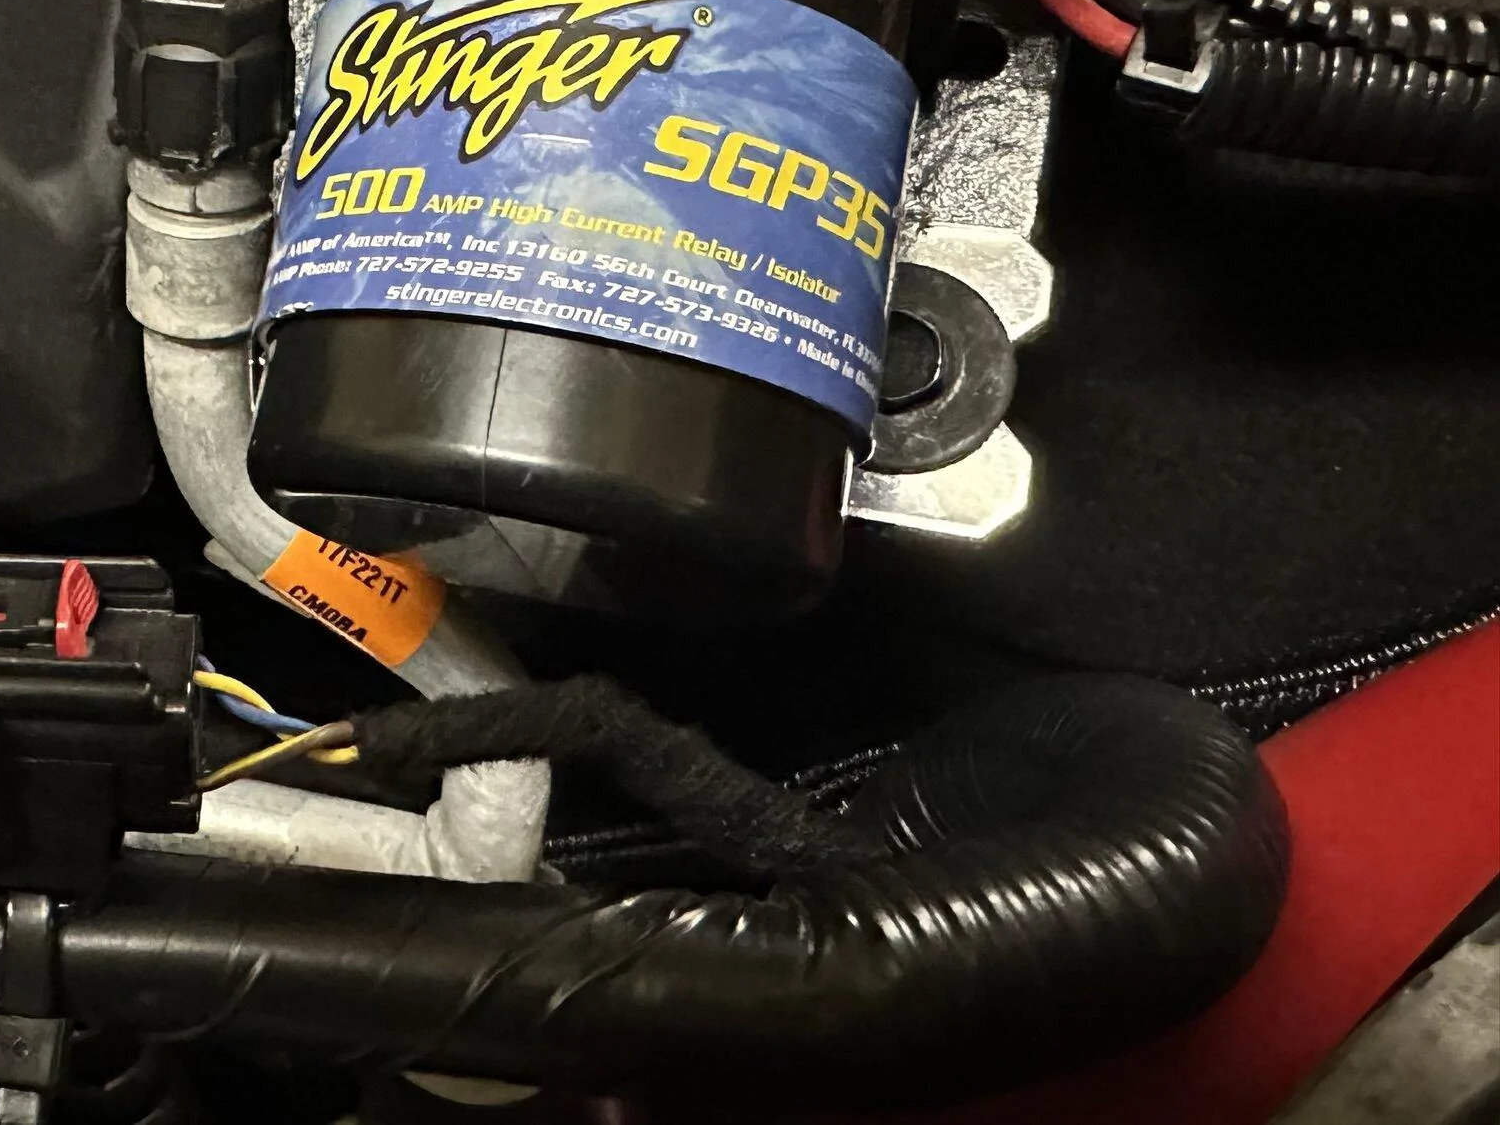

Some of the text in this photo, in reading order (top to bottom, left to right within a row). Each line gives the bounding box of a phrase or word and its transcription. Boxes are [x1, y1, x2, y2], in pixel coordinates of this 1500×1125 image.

[315, 166, 426, 219] 500
[421, 194, 484, 215] AMP
[488, 197, 553, 225] High
[560, 206, 667, 245] Current
[674, 229, 748, 272] Relay
[765, 257, 842, 304] Isolator
[643, 114, 891, 260] SGP35
[299, 259, 352, 278] Phone:
[356, 256, 526, 282] 727-572-9255
[537, 270, 598, 295] Fax:
[602, 281, 781, 343] 727-573-9326
[797, 338, 841, 371] Made
[322, 233, 343, 251] of
[461, 234, 500, 254] Inc
[505, 239, 588, 265] 13160
[592, 253, 656, 280] 56th
[662, 269, 728, 300] Court
[385, 282, 698, 348] stingerelectronics.com
